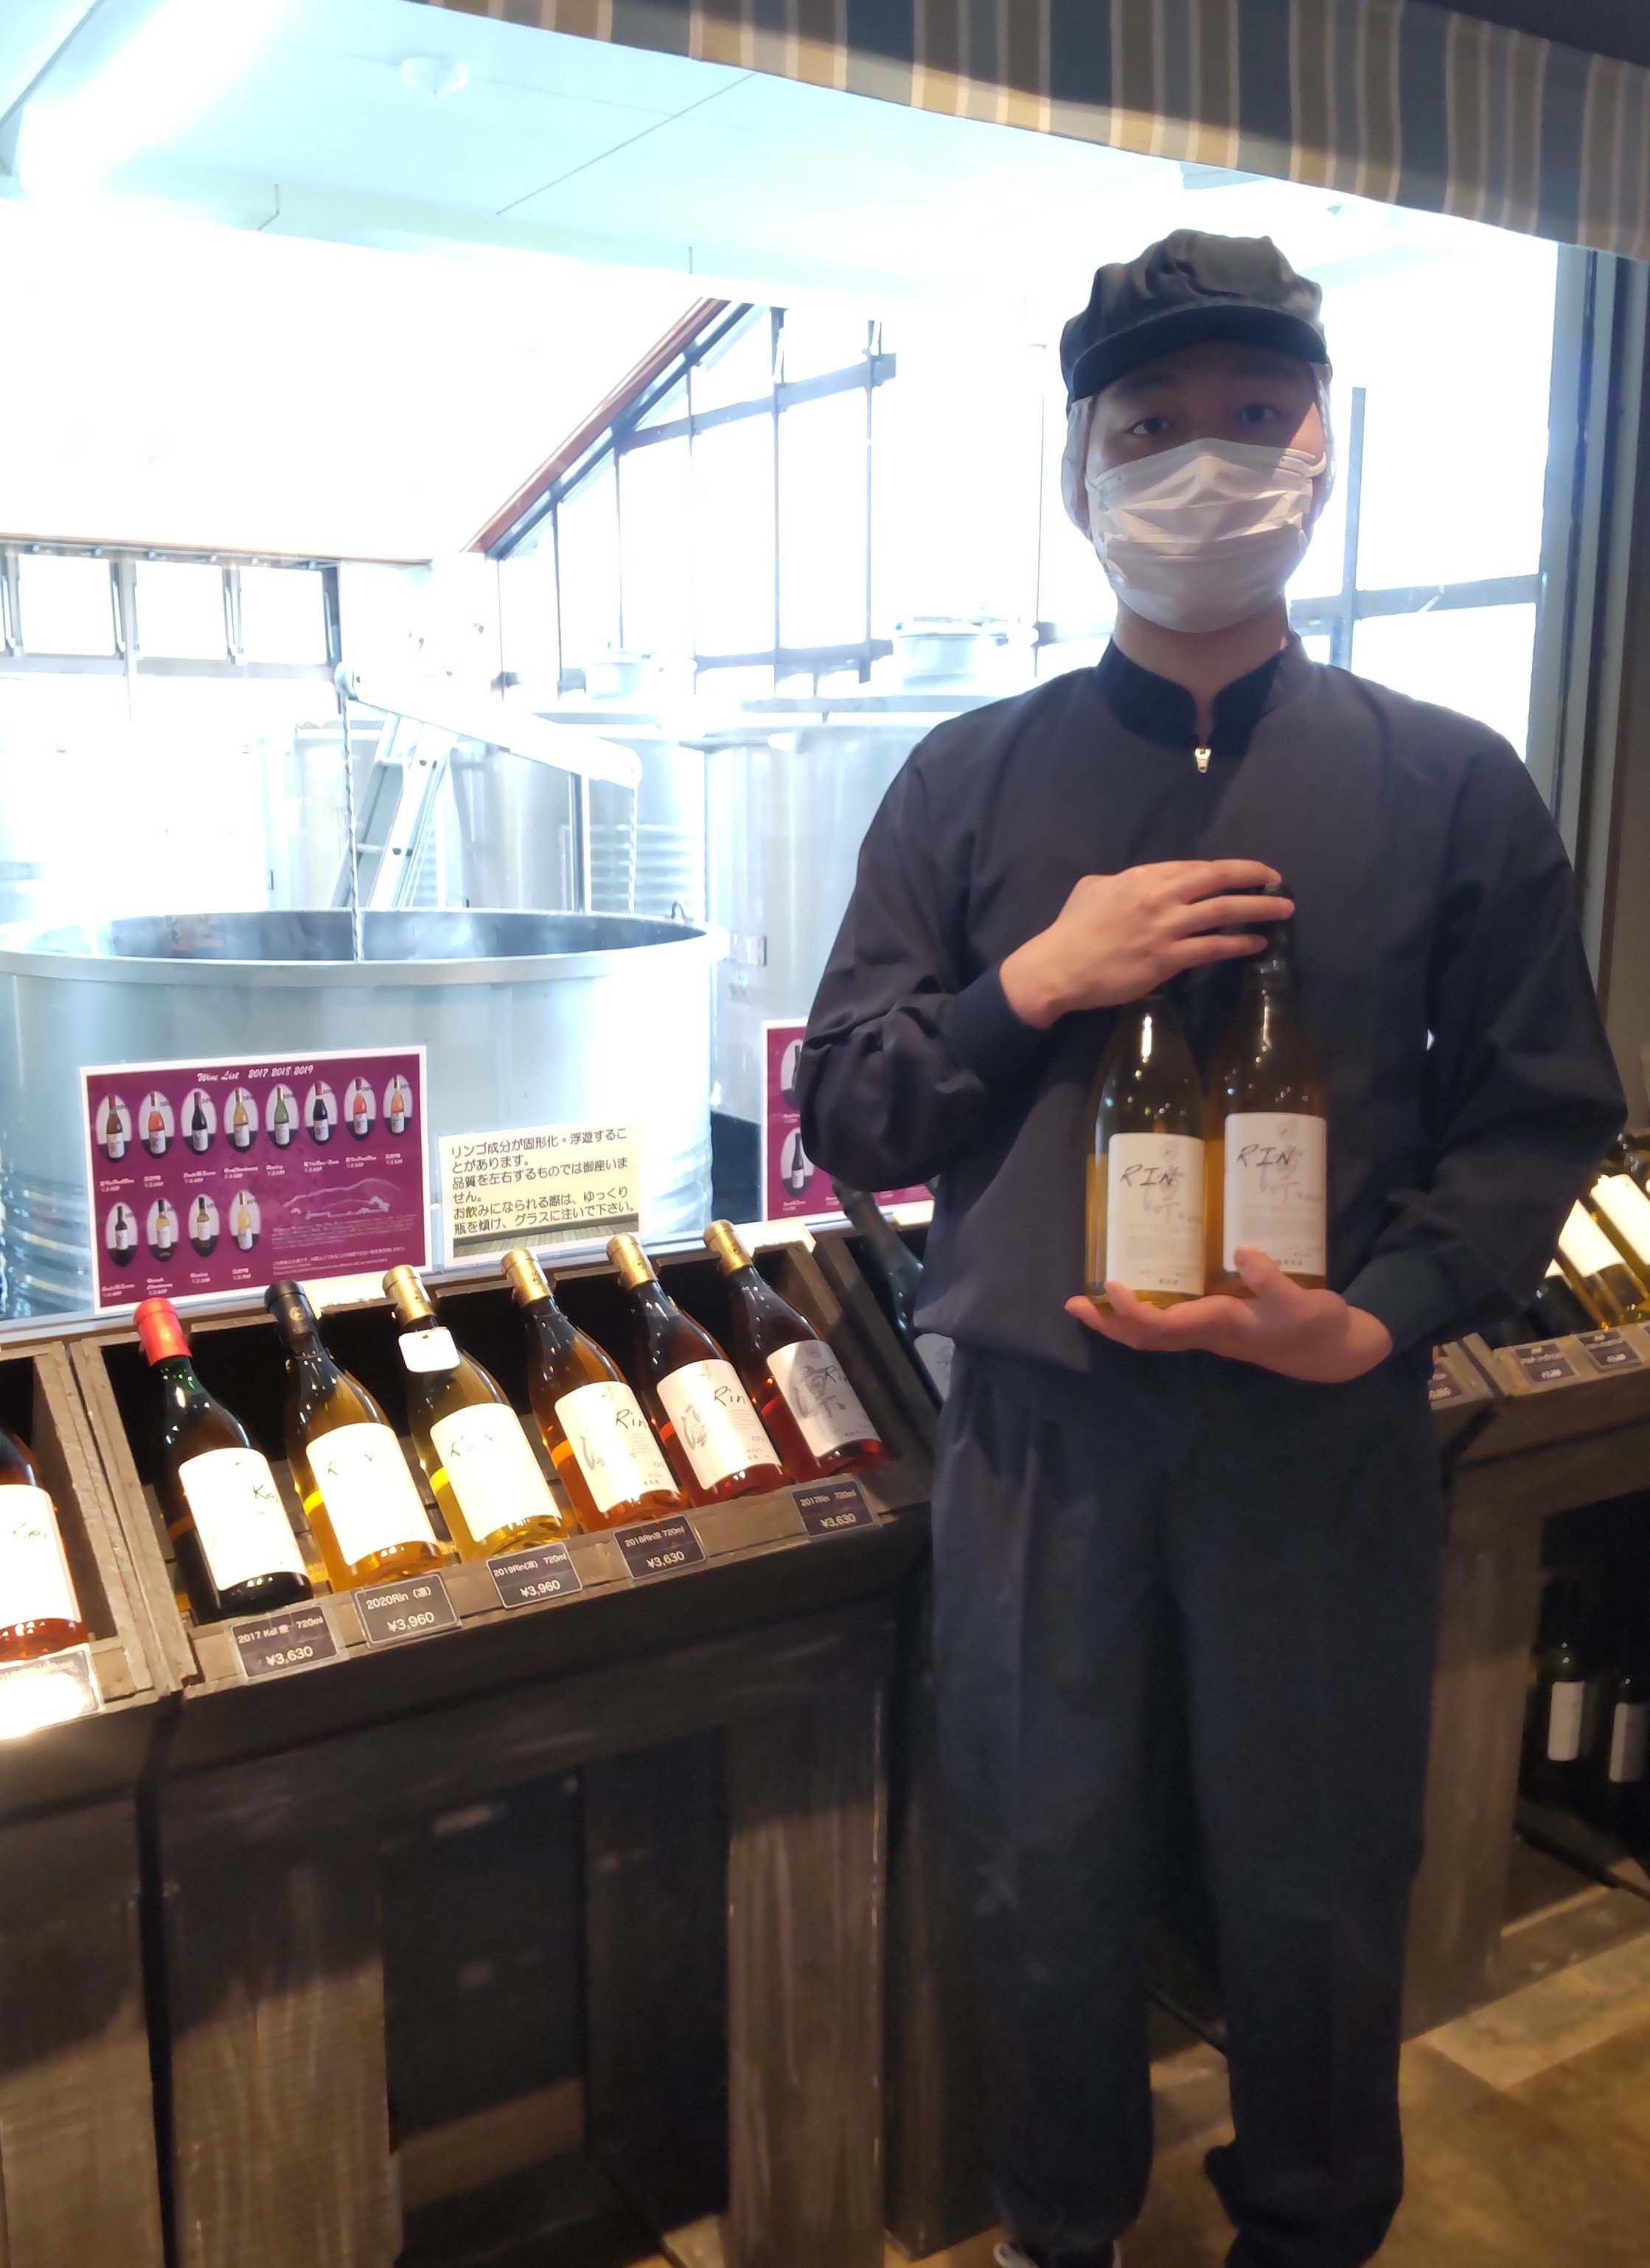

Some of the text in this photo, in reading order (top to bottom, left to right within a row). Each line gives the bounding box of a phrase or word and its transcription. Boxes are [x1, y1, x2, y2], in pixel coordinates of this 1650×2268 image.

[220, 1070, 239, 1081] List
[248, 1069, 268, 1079] 2017
[271, 1067, 292, 1077] 2018
[293, 1065, 313, 1075] 2019
[453, 1154, 529, 1173] とがあります。
[1237, 1143, 1297, 1168] RIN
[453, 1157, 627, 1190] 品質を左右するものでは御座いま
[1120, 1163, 1180, 1187] RIN
[453, 1190, 481, 1204] せん。
[714, 1386, 745, 1406] Rin
[616, 1409, 647, 1429] Rin
[543, 1552, 567, 1565] 720ml
[646, 1551, 685, 1569] ¥3,630
[519, 1580, 560, 1597] ¥3,960
[366, 1592, 409, 1610] 2020Rin
[237, 1630, 261, 1644] 2017
[296, 1616, 324, 1629] 720ml
